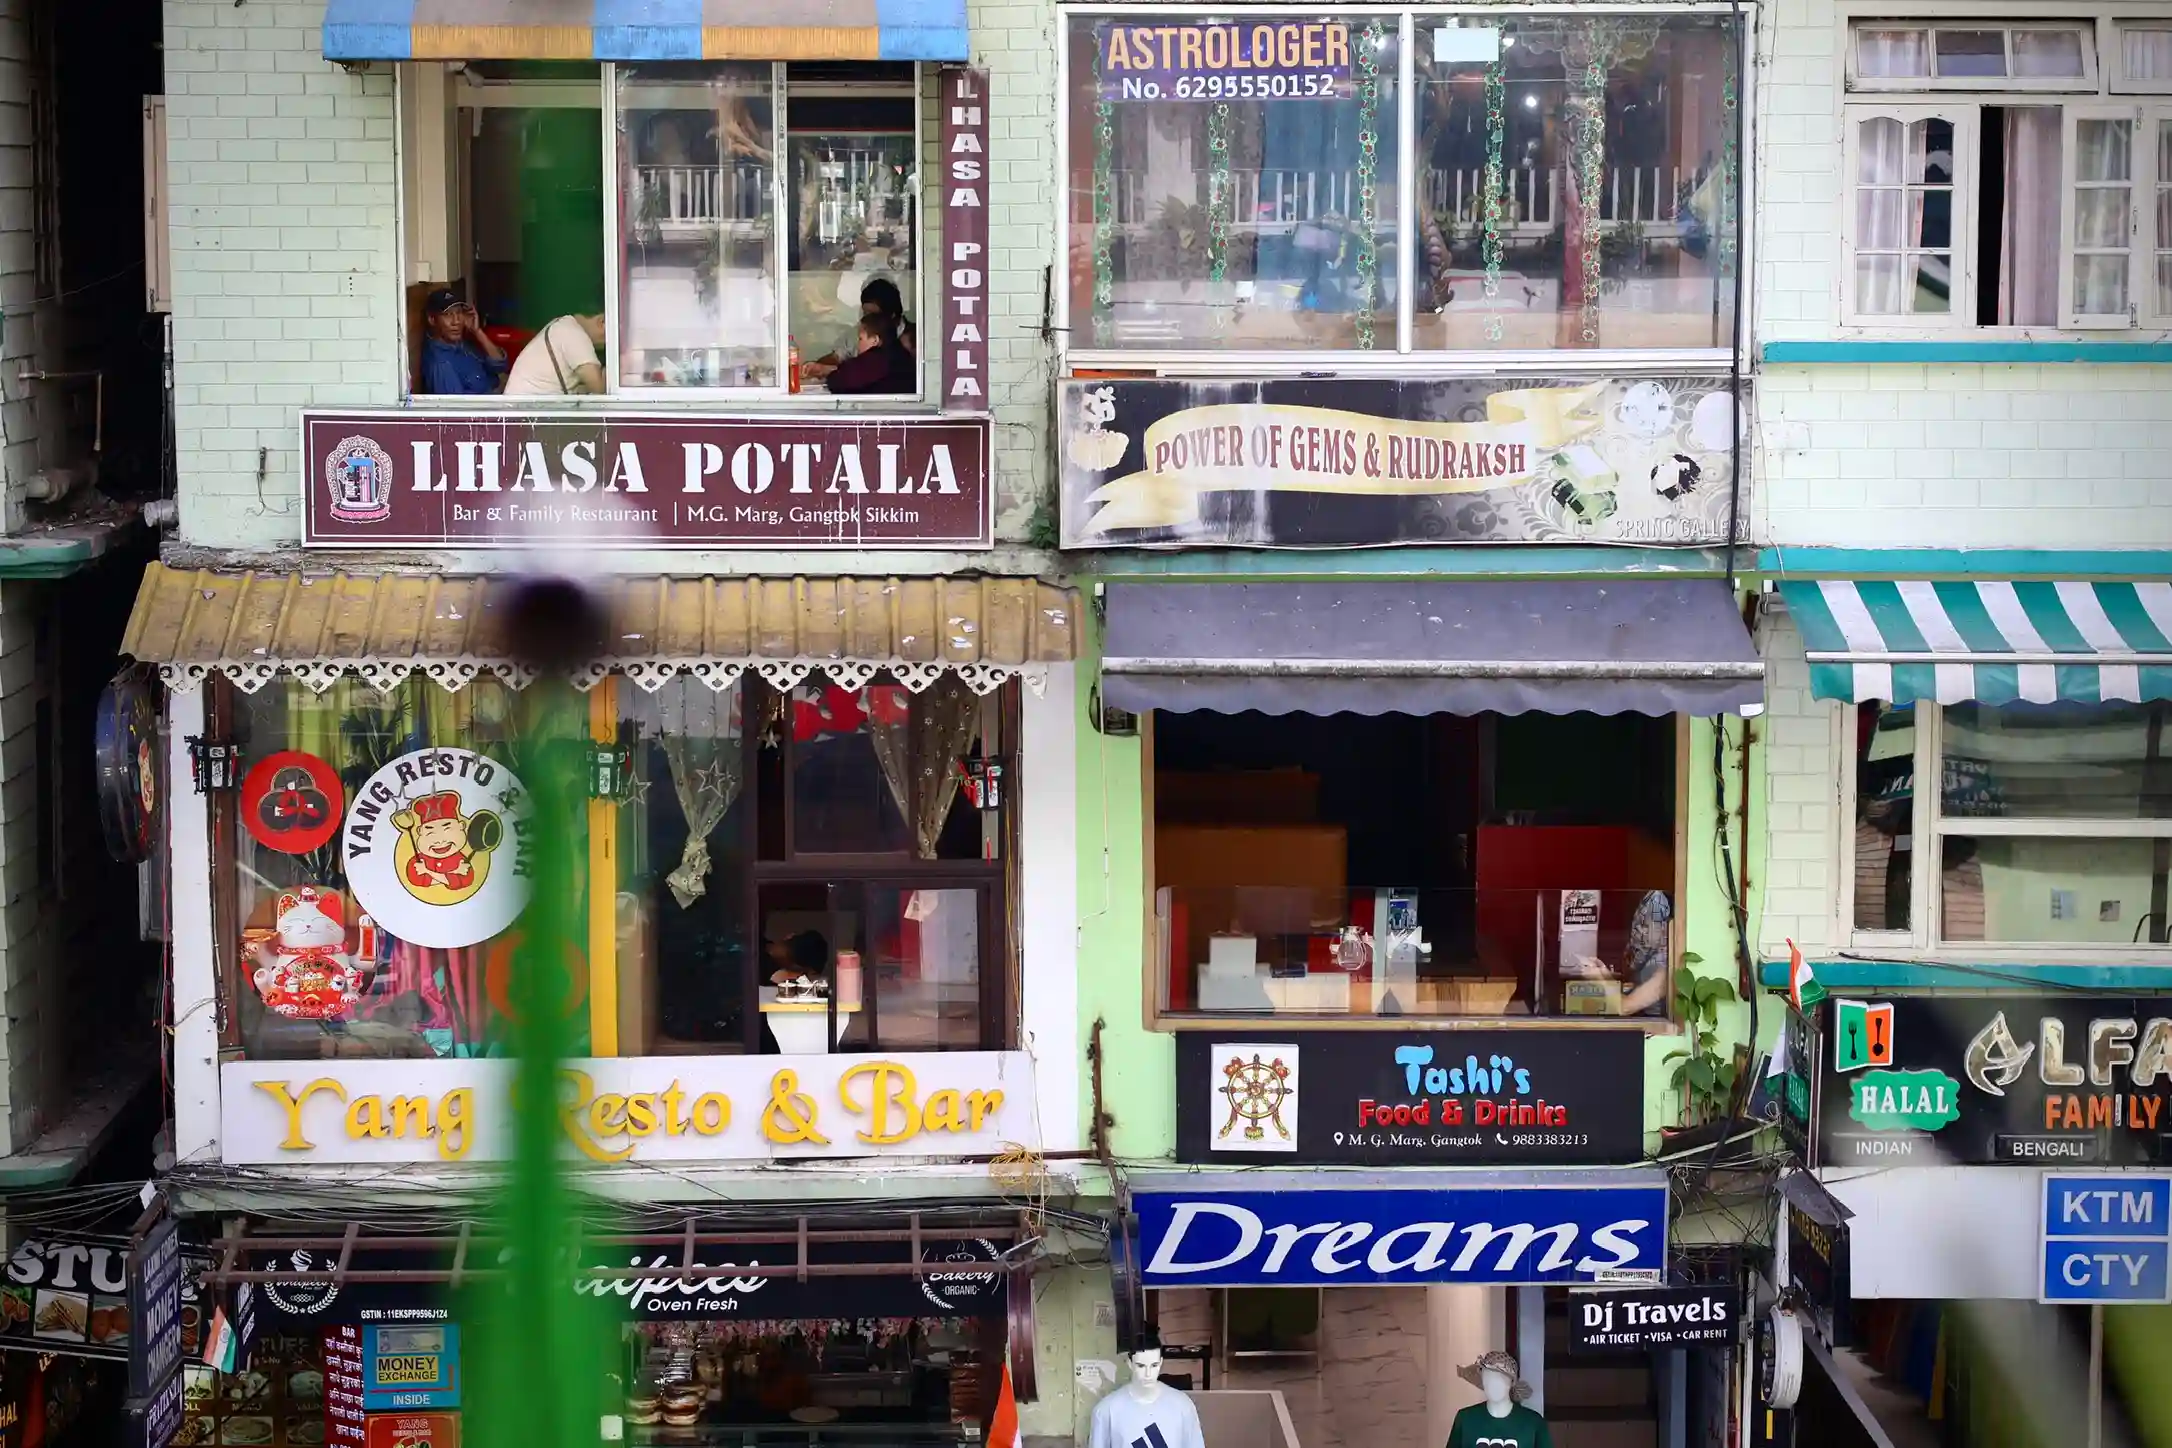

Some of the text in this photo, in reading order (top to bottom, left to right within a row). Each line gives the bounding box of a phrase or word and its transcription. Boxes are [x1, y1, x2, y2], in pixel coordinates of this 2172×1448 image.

[1107, 24, 1349, 70] ASTROLOGER
[1122, 74, 1335, 99] No. 6295550152
[950, 79, 983, 206] LHASA
[950, 242, 982, 396] POTALA
[1155, 425, 1526, 480] POWER OF GEMS & RUDRAKSH
[410, 441, 961, 494] LHASA POTALA
[453, 504, 658, 524] Bar & Family Restaurant
[687, 506, 919, 525] M.G. Marg, Gangtok Sikkim
[1679, 518, 1750, 539] GALLEY
[349, 781, 396, 859] YANG
[394, 753, 495, 787] RESTO
[1394, 1045, 1531, 1096] Tashi's
[251, 1076, 474, 1161] Yang
[762, 1068, 832, 1144] &
[838, 1060, 1005, 1145] Bar
[1358, 1098, 1569, 1127] Food & Drinks
[1860, 1086, 1949, 1114] HALAL
[2045, 1093, 2161, 1130] FAMILY
[1349, 1133, 1366, 1146] M.
[1370, 1133, 1385, 1147] G.
[1431, 1133, 1483, 1148] Gangtok
[1512, 1134, 1588, 1146] 9883383213
[1856, 1141, 1912, 1155] INDIAN
[2013, 1142, 2084, 1156] BENGALI
[2063, 1190, 2154, 1223] KTM
[1145, 1202, 1650, 1276] Dreams
[2062, 1253, 2150, 1286] CTY
[361, 1310, 382, 1320] GSTIN
[647, 1297, 738, 1312] Oven Fresh
[1583, 1297, 1727, 1332] Dj Travels
[1589, 1328, 1728, 1345] AIR TICKET VISA CAR RENT
[378, 1357, 436, 1371] MONEY
[378, 1371, 437, 1382] EXCHANGE
[392, 1394, 431, 1405] INSIDE
[396, 1418, 429, 1429] YANG
